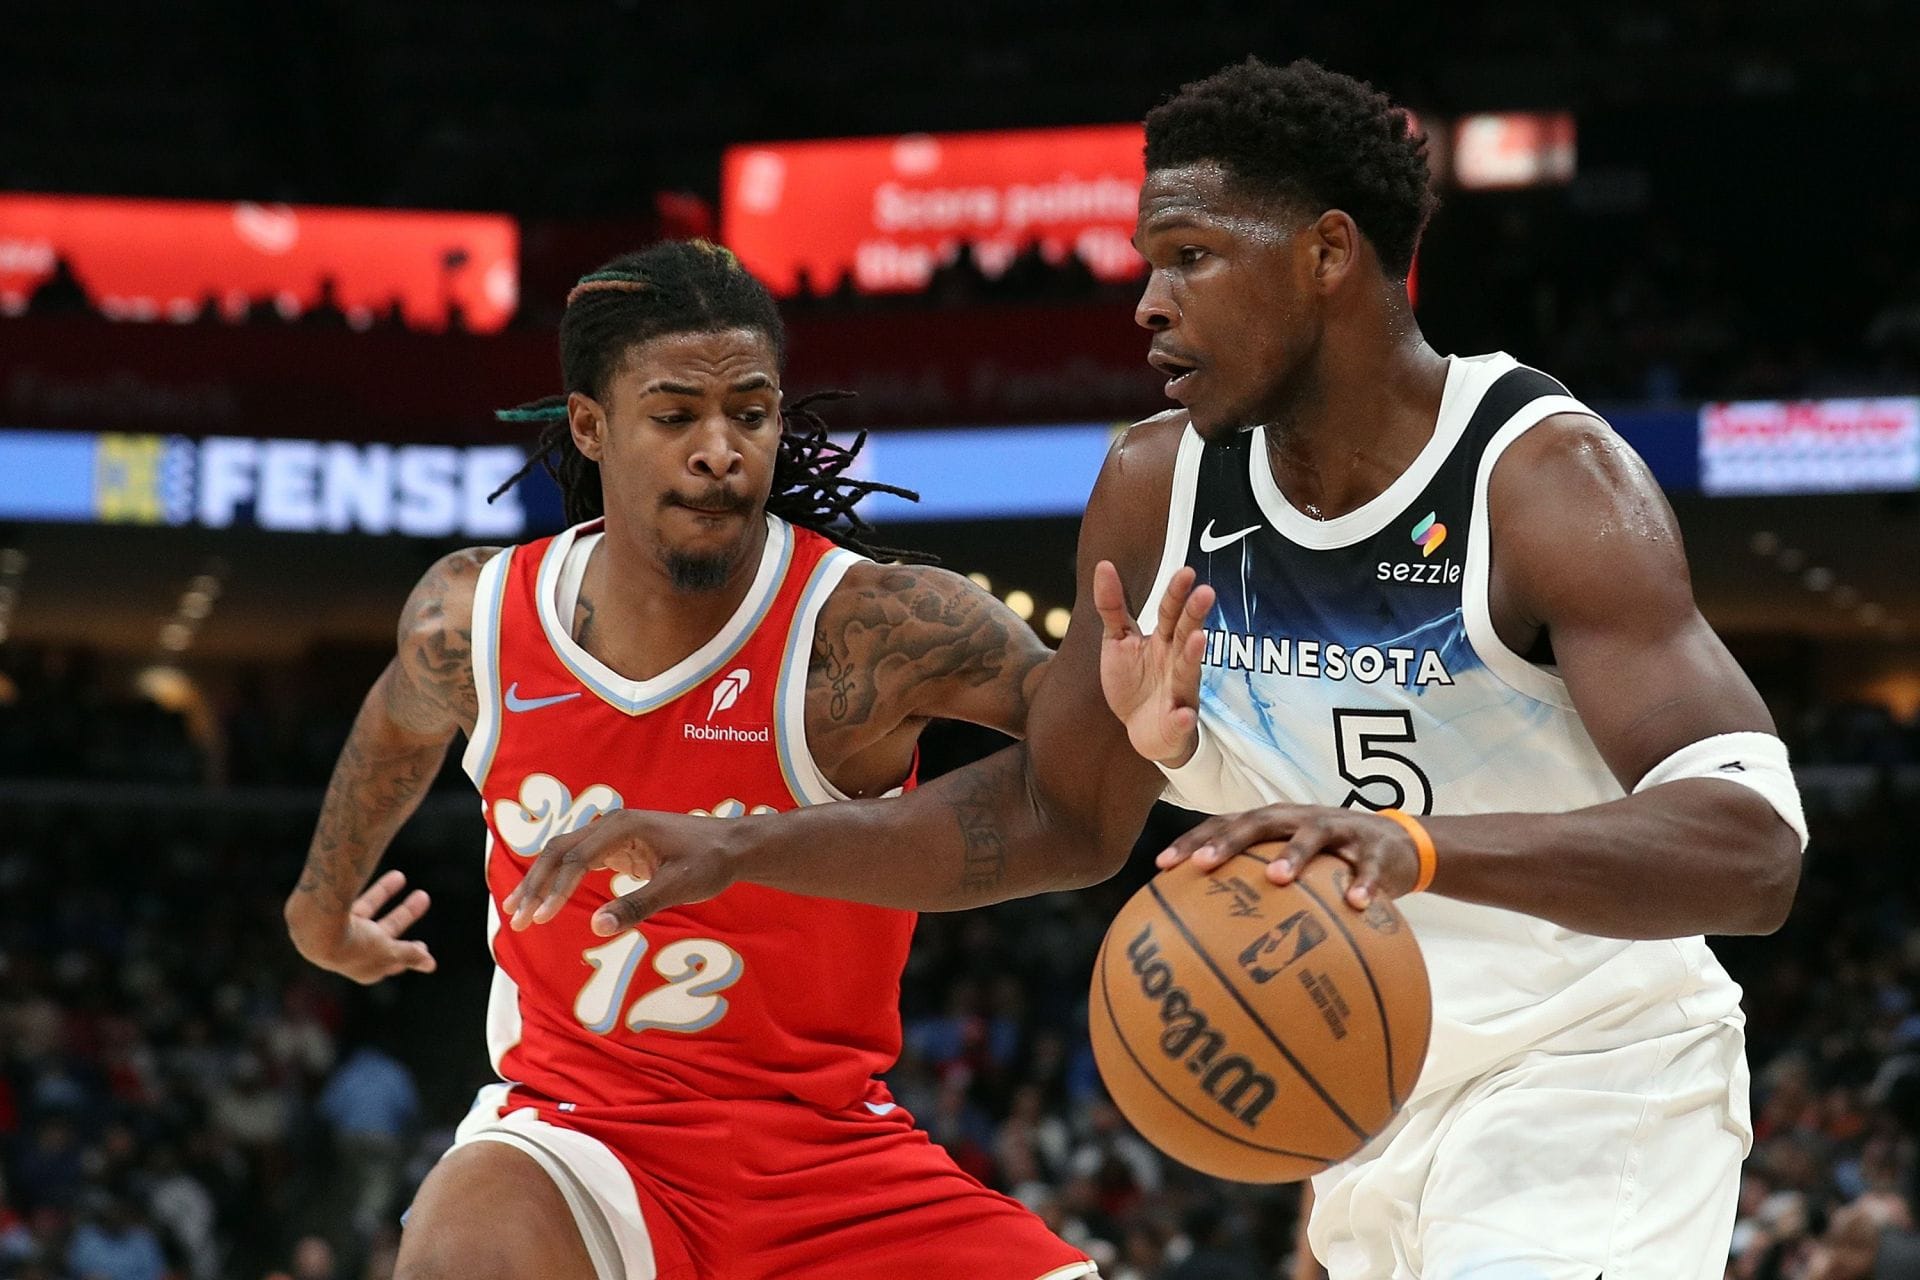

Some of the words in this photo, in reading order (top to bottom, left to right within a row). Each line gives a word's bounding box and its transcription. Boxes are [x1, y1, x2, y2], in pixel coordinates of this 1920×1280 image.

[201, 434, 526, 538] FENSE
[1377, 558, 1461, 584] sezzle
[684, 723, 769, 742] Robinhood
[1332, 708, 1433, 815] 5
[575, 929, 744, 1035] 12
[1126, 922, 1280, 1130] Wilson
